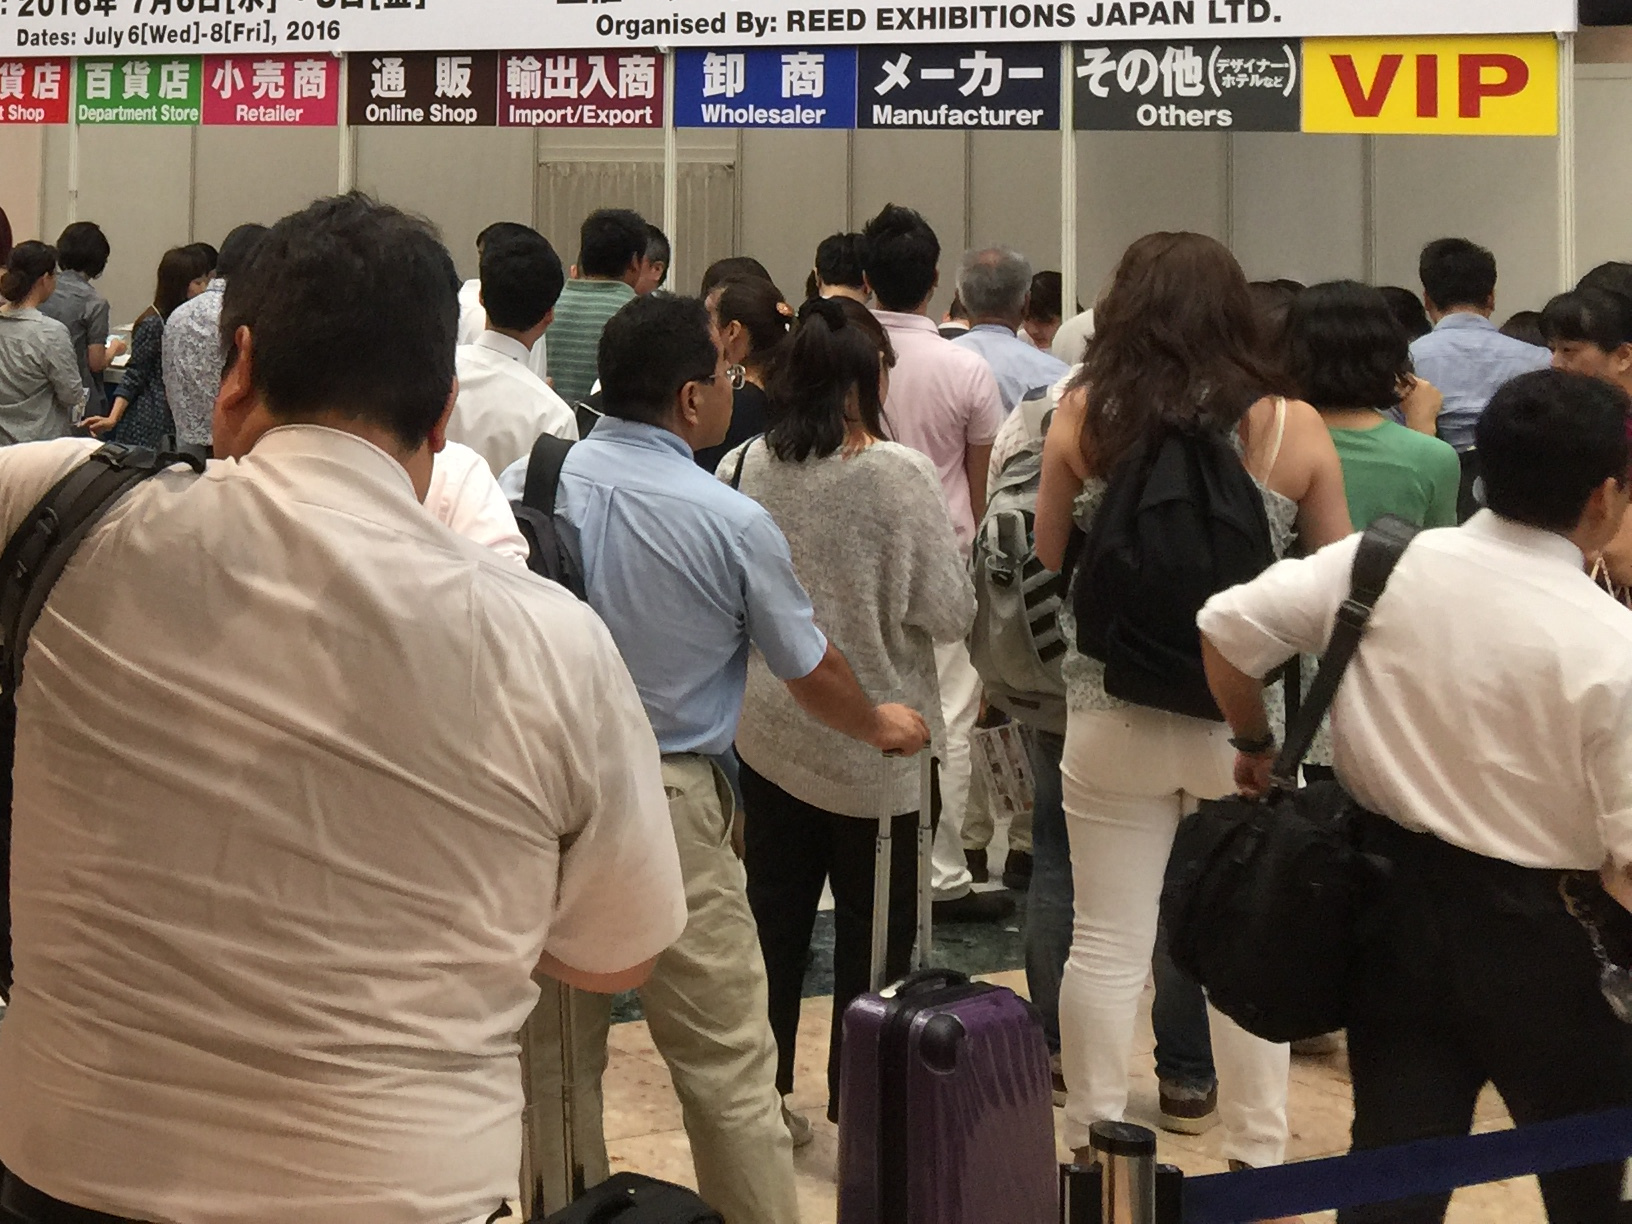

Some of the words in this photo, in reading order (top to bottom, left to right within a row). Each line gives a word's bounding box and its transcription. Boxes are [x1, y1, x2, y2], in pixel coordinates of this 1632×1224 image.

[596, 13, 726, 39] Organised
[736, 11, 777, 37] By:
[787, 8, 866, 32] REED
[876, 4, 1075, 31] EXHIBITIONS
[1087, 0, 1195, 27] JAPAN
[16, 26, 76, 47] Dates:
[83, 25, 123, 48] July
[286, 20, 340, 41] 2016
[85, 61, 190, 100] 百貨店
[211, 59, 326, 99] 小売商
[371, 56, 472, 99] 通販
[506, 55, 655, 100] 輸出入商
[702, 51, 825, 99] 卸商
[874, 50, 1044, 97] メーカー
[1329, 53, 1530, 118] VIP
[8, 104, 45, 123] Shop
[78, 104, 156, 123] Department
[160, 104, 199, 121] Store
[236, 104, 304, 122] Retailer
[366, 104, 425, 122] Online
[429, 104, 478, 125] Shop
[509, 104, 653, 126] Import/Export
[701, 104, 826, 125] Wholesaler
[873, 104, 1044, 126] Manufacturer
[1136, 104, 1233, 127] Others
